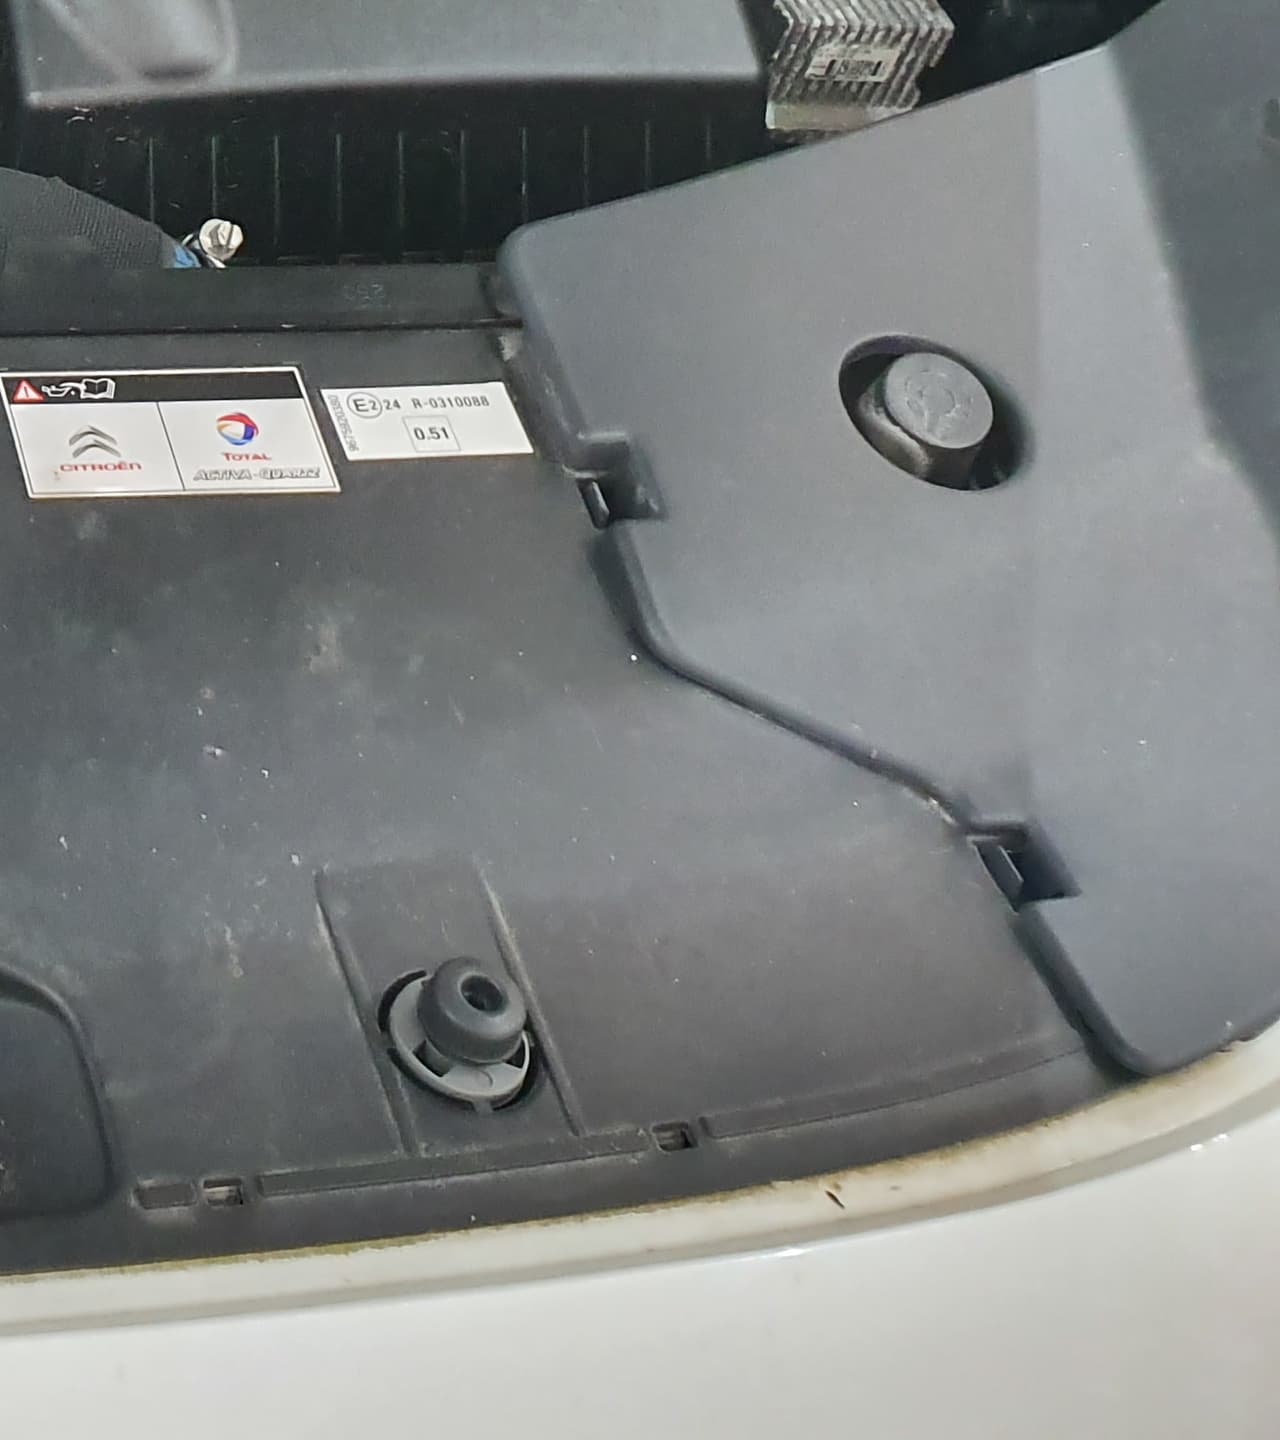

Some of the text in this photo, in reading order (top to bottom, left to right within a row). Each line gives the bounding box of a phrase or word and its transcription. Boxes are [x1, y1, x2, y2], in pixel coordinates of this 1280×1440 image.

[383, 400, 401, 410] 24
[411, 395, 490, 409] R-0310088
[413, 426, 451, 441] 0.51
